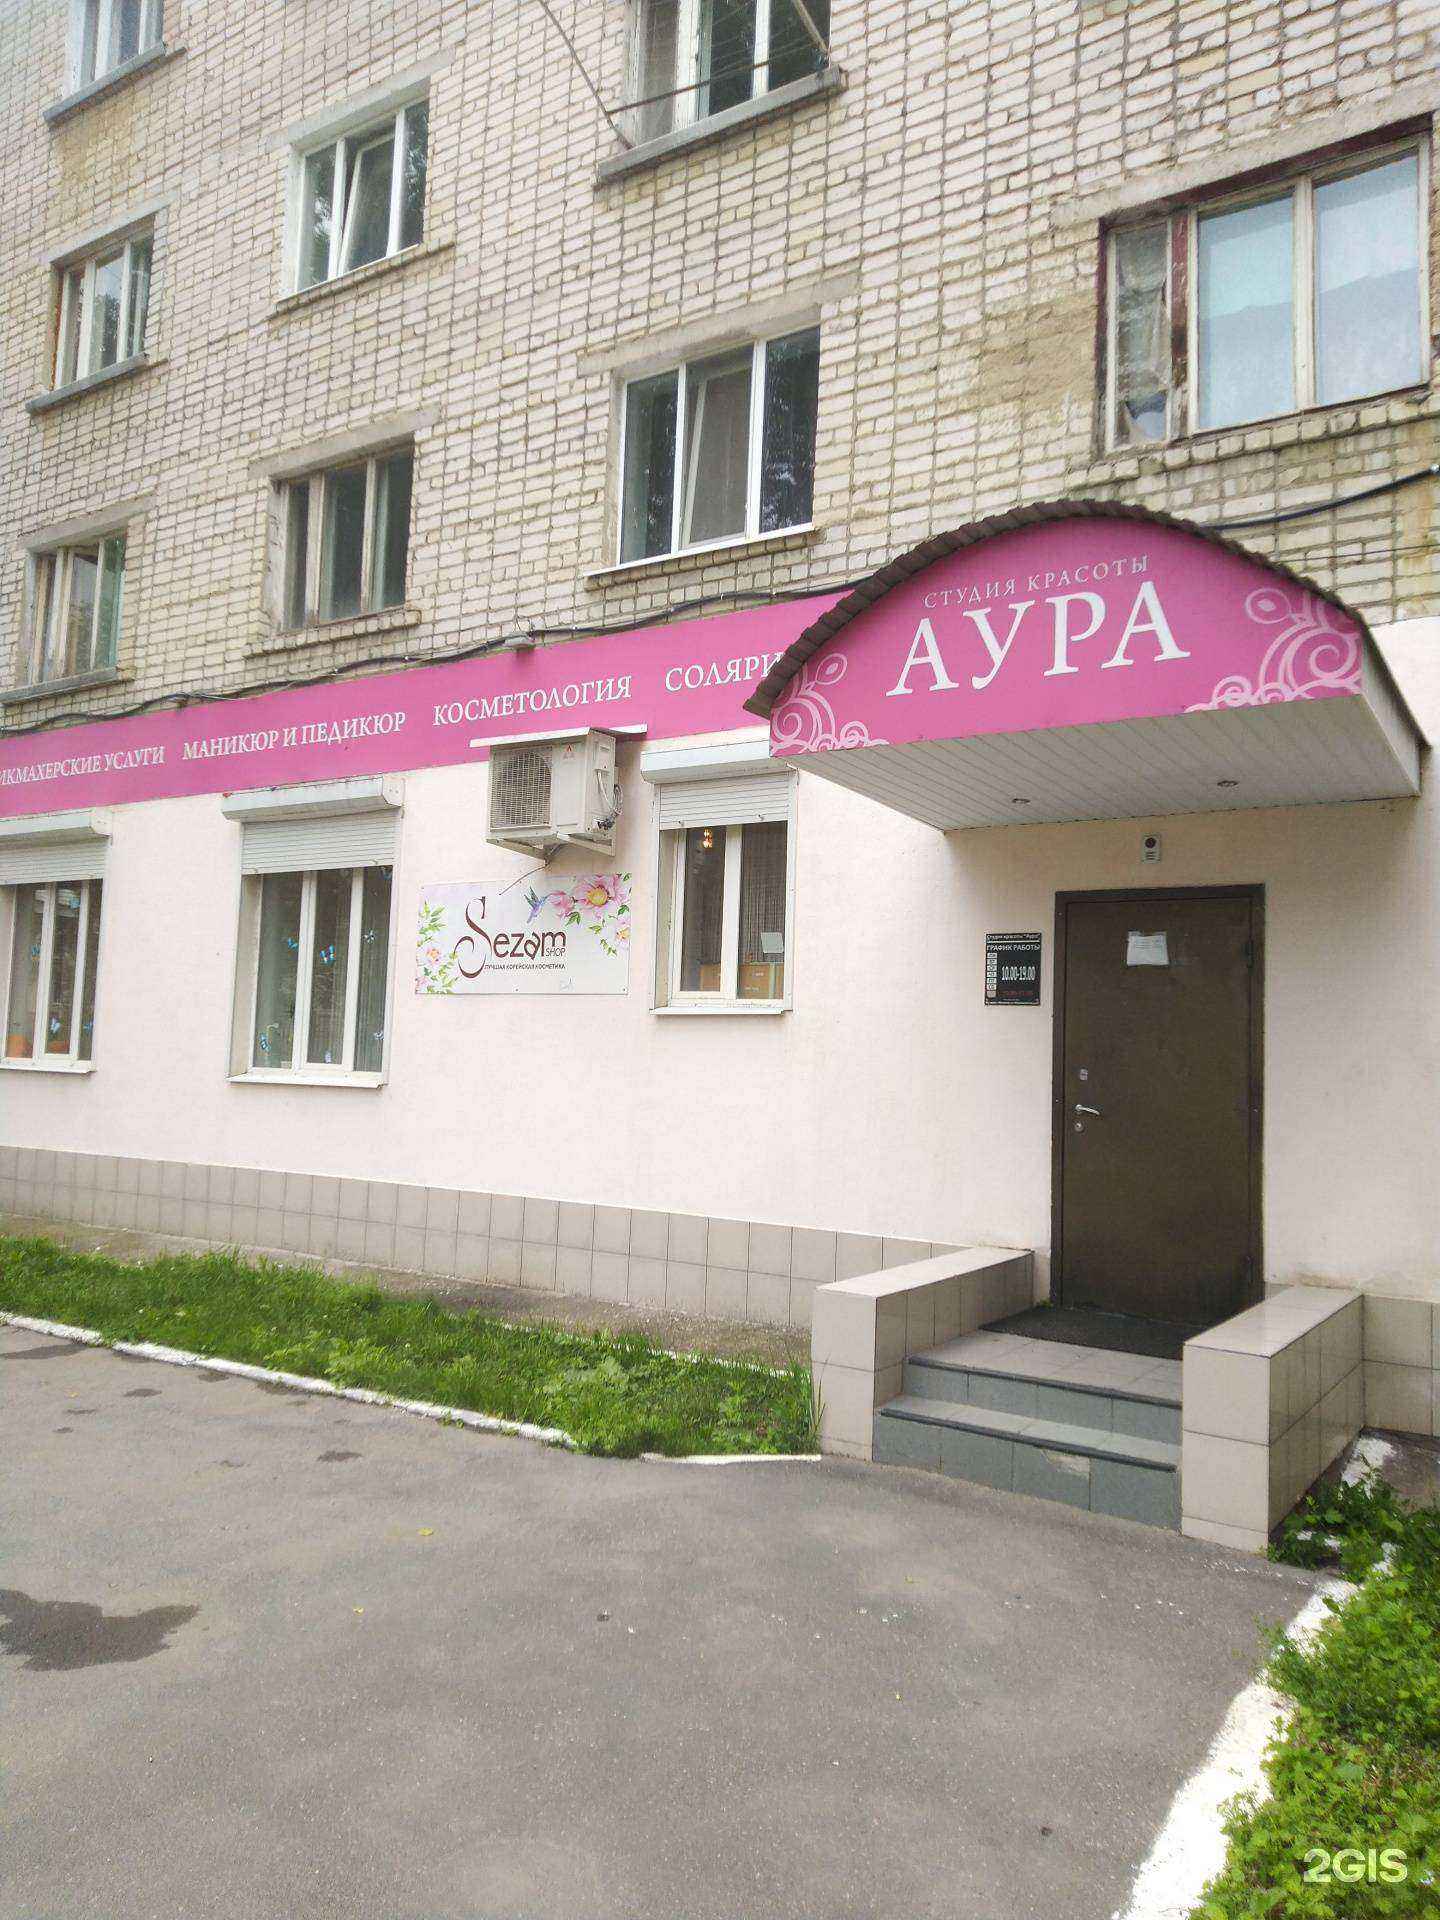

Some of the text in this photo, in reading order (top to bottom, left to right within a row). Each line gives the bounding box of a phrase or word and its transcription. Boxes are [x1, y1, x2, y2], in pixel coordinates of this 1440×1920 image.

[923, 554, 1149, 608] СТУДИЯ КРАСОТЫ
[885, 581, 1191, 696] АУРА
[104, 746, 166, 771] УСЛУГИ
[182, 730, 279, 760] МАНИКЮР
[283, 727, 298, 747] И
[301, 712, 406, 745] ПЕДИКЮР
[432, 676, 632, 726] КОСМЕТОЛОГИЯ
[454, 896, 567, 979] Sezam
[545, 948, 566, 957] SHOP
